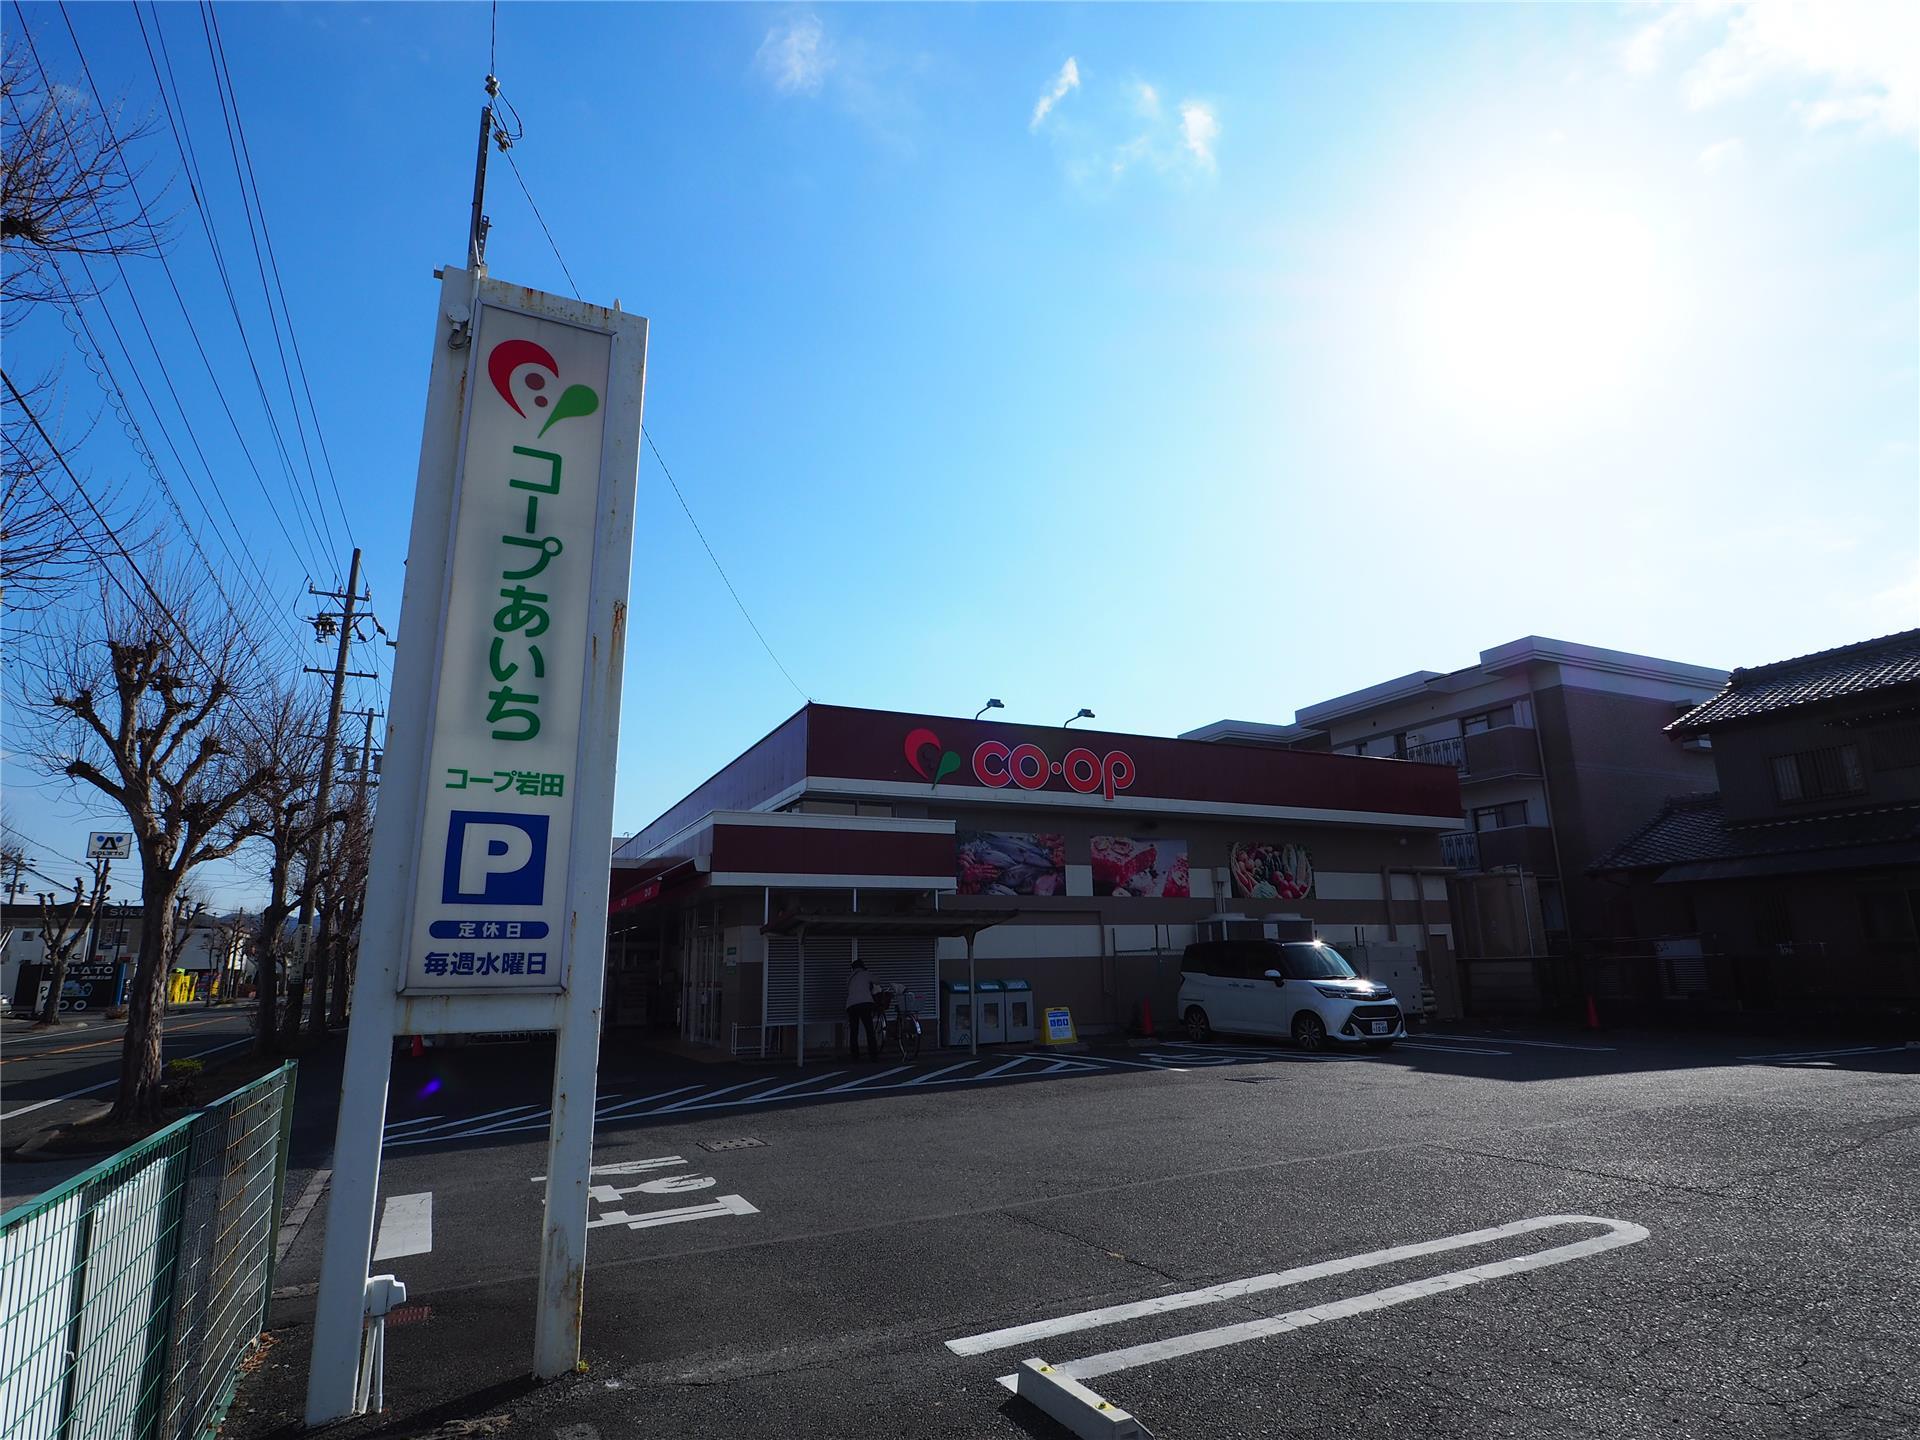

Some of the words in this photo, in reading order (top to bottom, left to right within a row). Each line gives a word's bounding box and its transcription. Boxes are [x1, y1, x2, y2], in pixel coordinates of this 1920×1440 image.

[486, 445, 563, 741] コープあいち
[445, 768, 565, 797] コープ岩田
[458, 822, 533, 895] P
[458, 922, 521, 938] 定休日
[424, 951, 547, 977] 毎週水曜日
